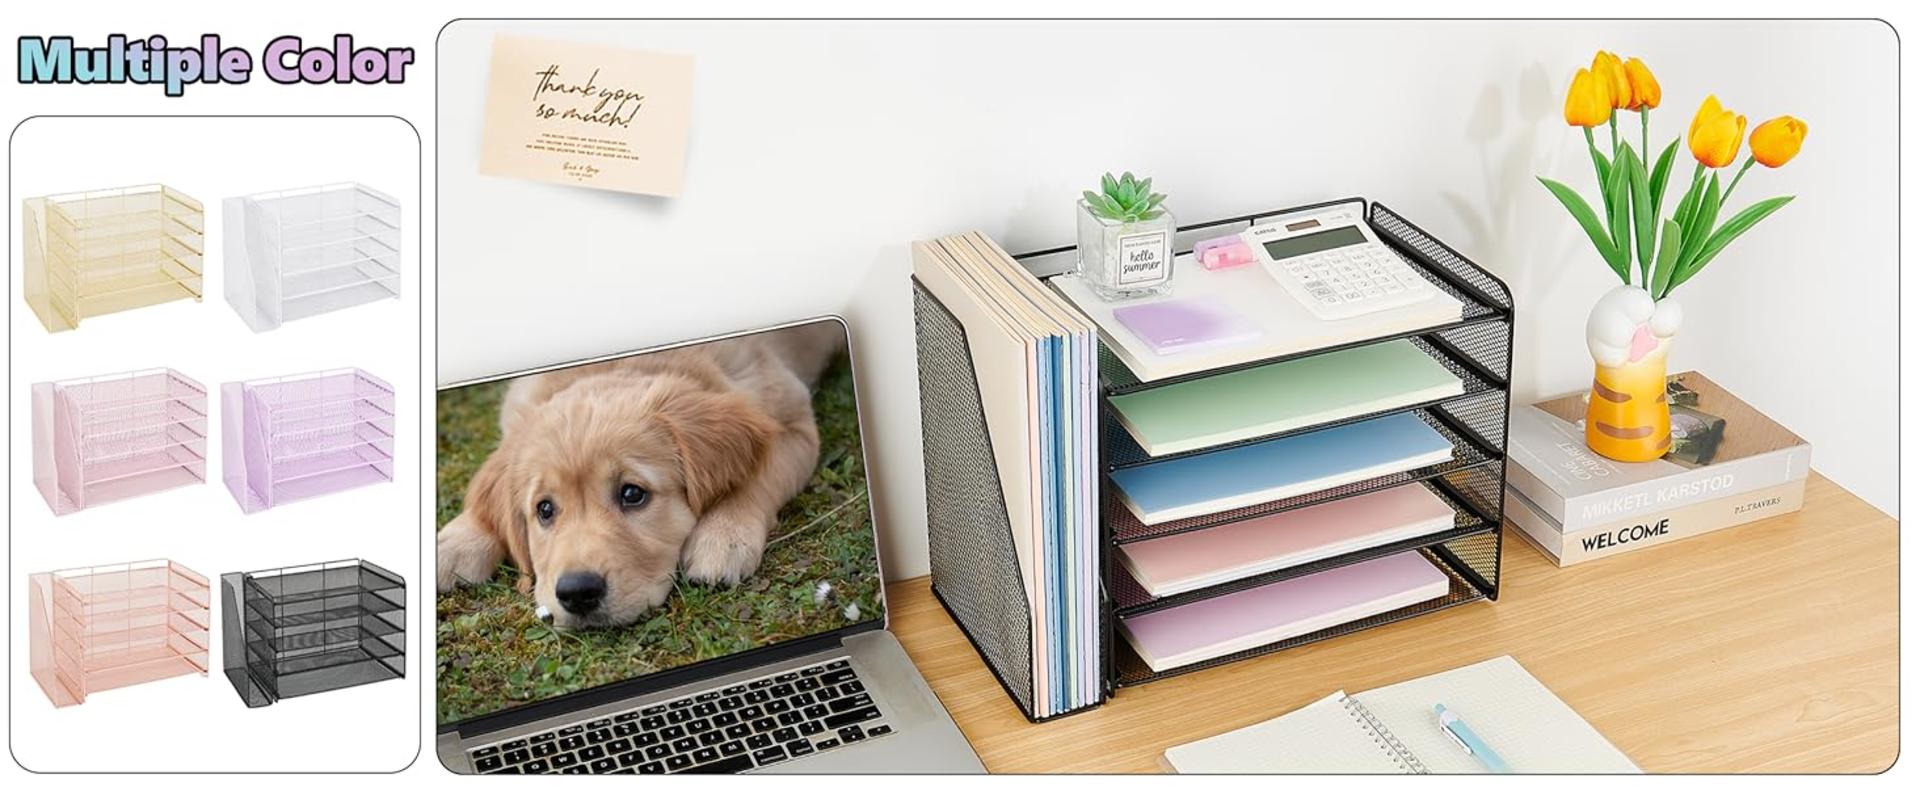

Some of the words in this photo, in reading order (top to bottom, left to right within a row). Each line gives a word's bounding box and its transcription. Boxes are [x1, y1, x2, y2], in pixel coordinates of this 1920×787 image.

[533, 64, 600, 101] thank
[594, 88, 644, 113] you
[536, 104, 559, 119] so
[562, 103, 641, 128] much!
[1123, 261, 1161, 275] summer
[1130, 250, 1154, 262] hello
[1655, 474, 1735, 503] KARSTOD
[1582, 518, 1671, 552] WELCOME
